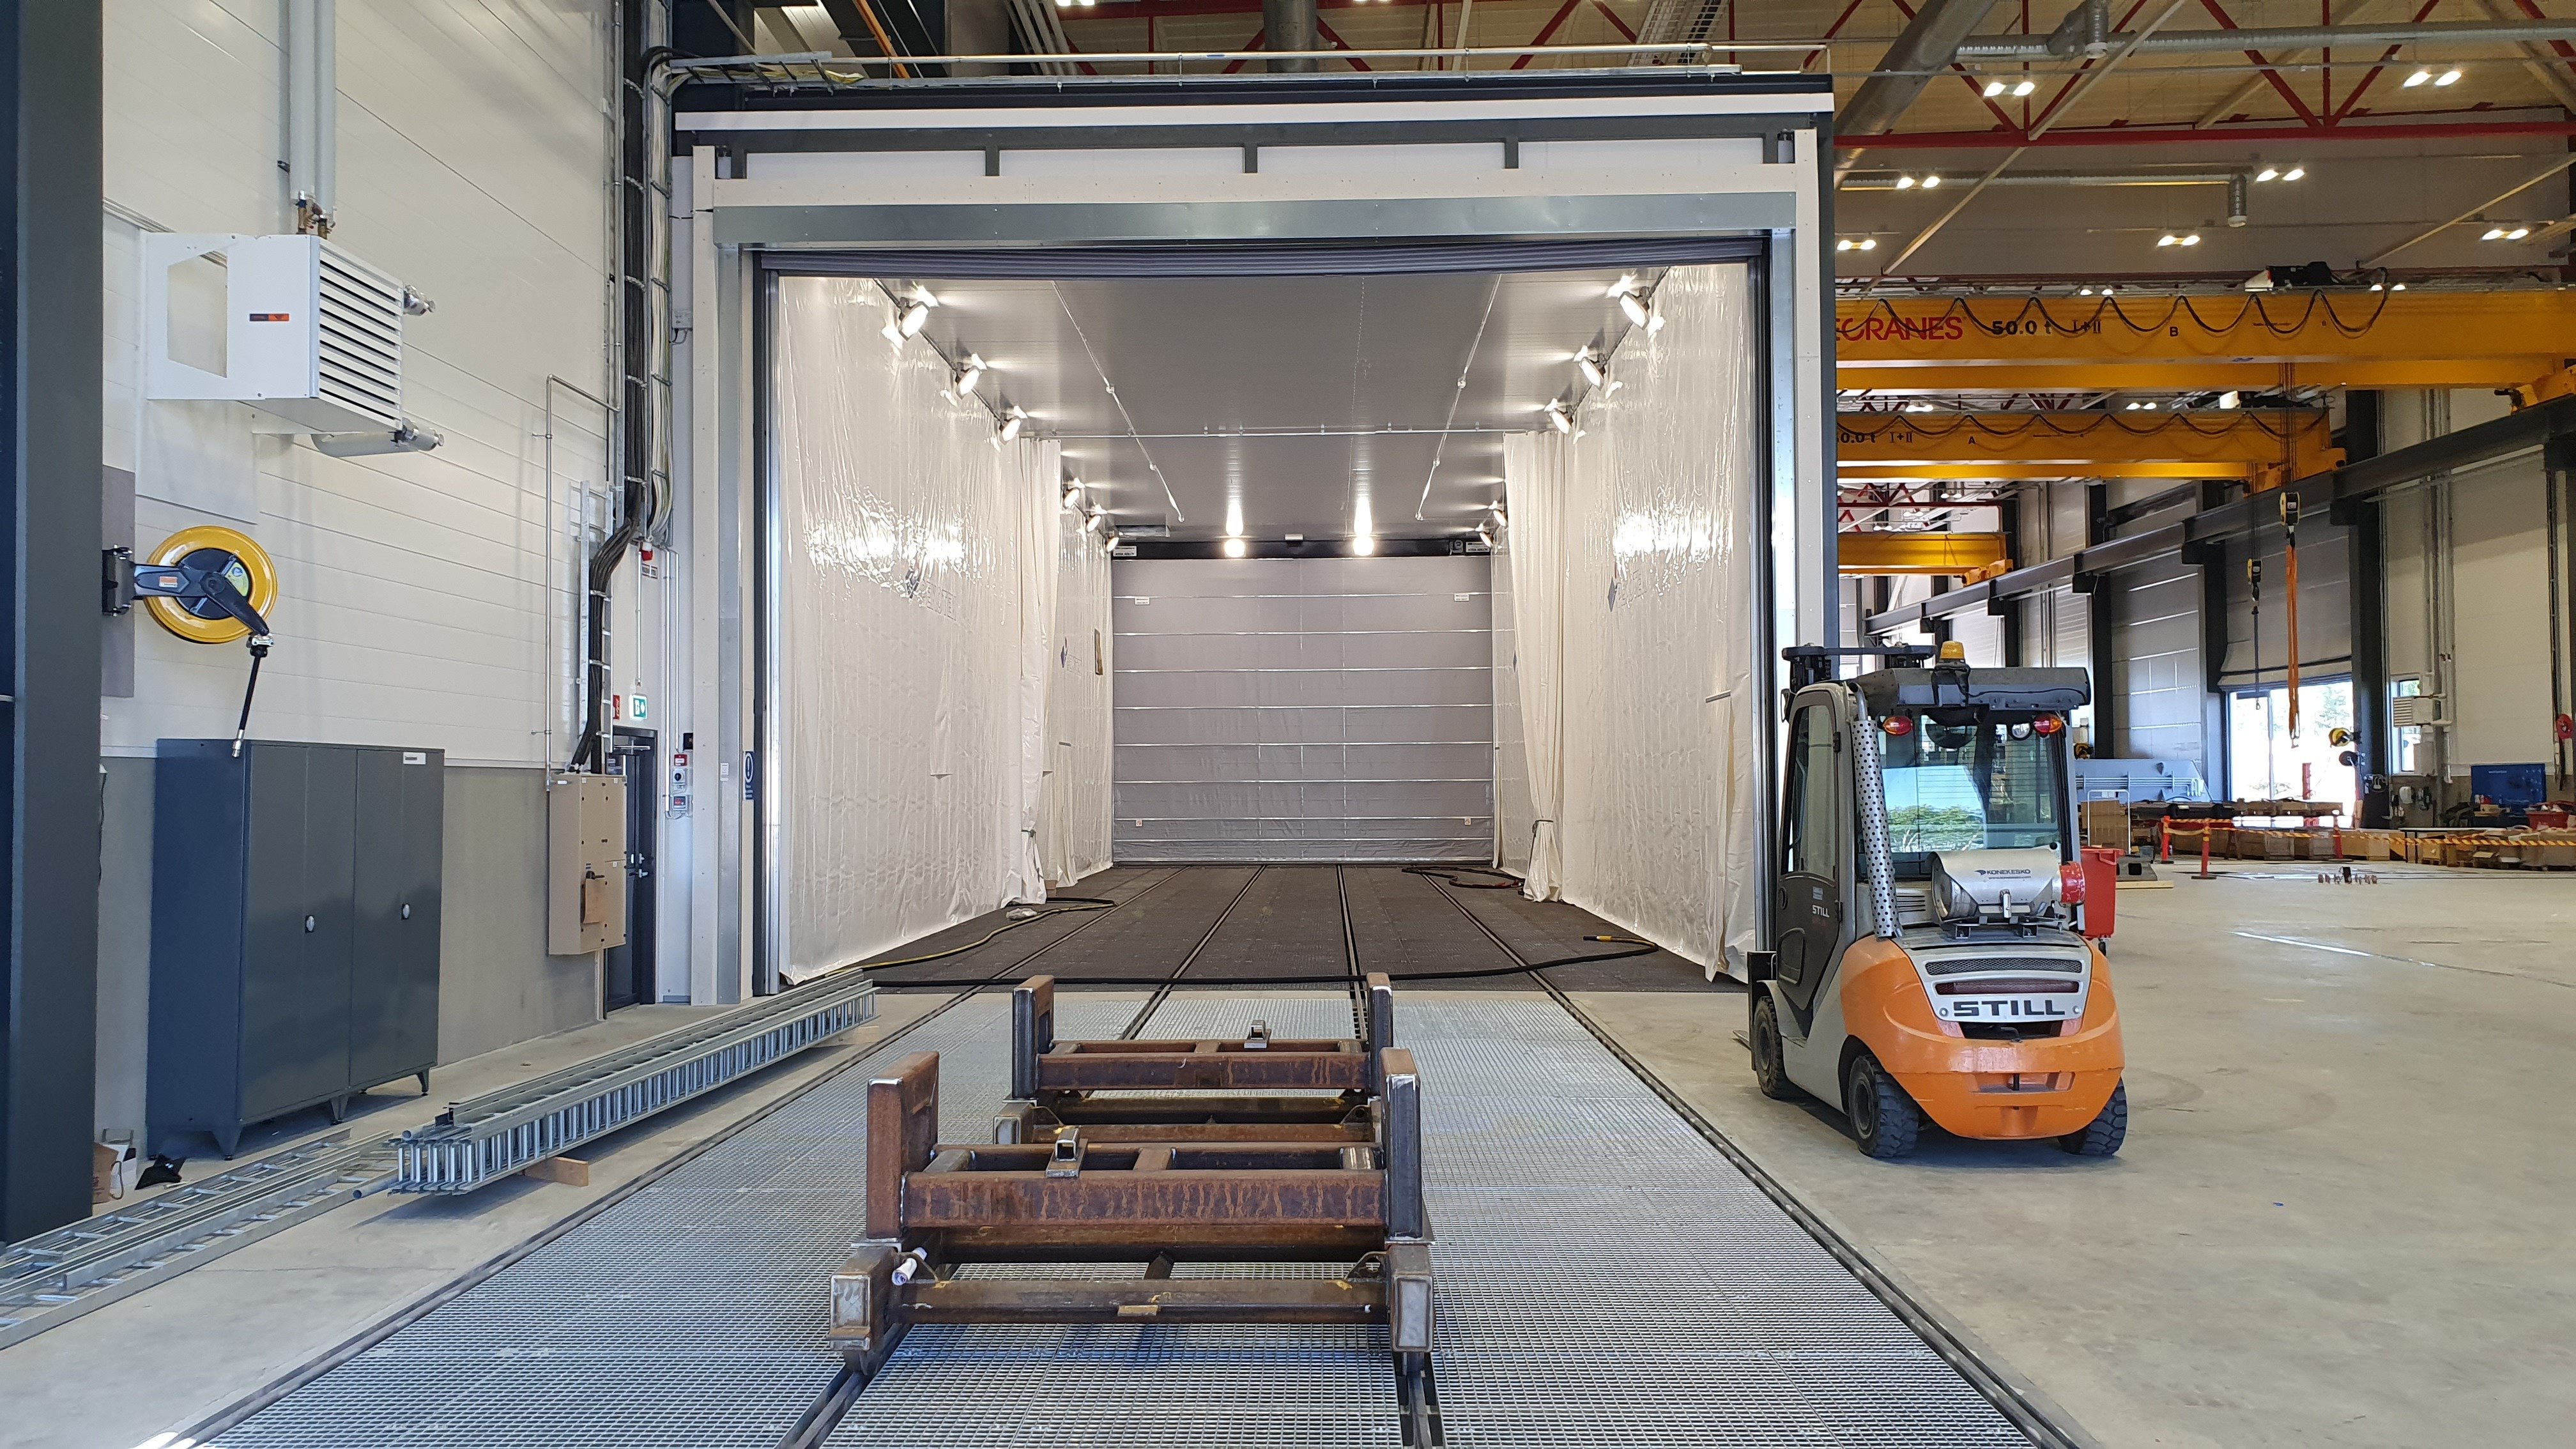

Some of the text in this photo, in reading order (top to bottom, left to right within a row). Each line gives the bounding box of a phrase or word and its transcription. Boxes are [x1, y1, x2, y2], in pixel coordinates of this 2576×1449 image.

[1836, 316, 1963, 341] CRANES
[1991, 320, 2037, 335] 50.0
[2169, 326, 2179, 337] B
[1837, 432, 1865, 443] 0.0
[1968, 436, 1977, 445] A
[1812, 904, 1830, 918] STILL
[1953, 1000, 2066, 1016] STILL
